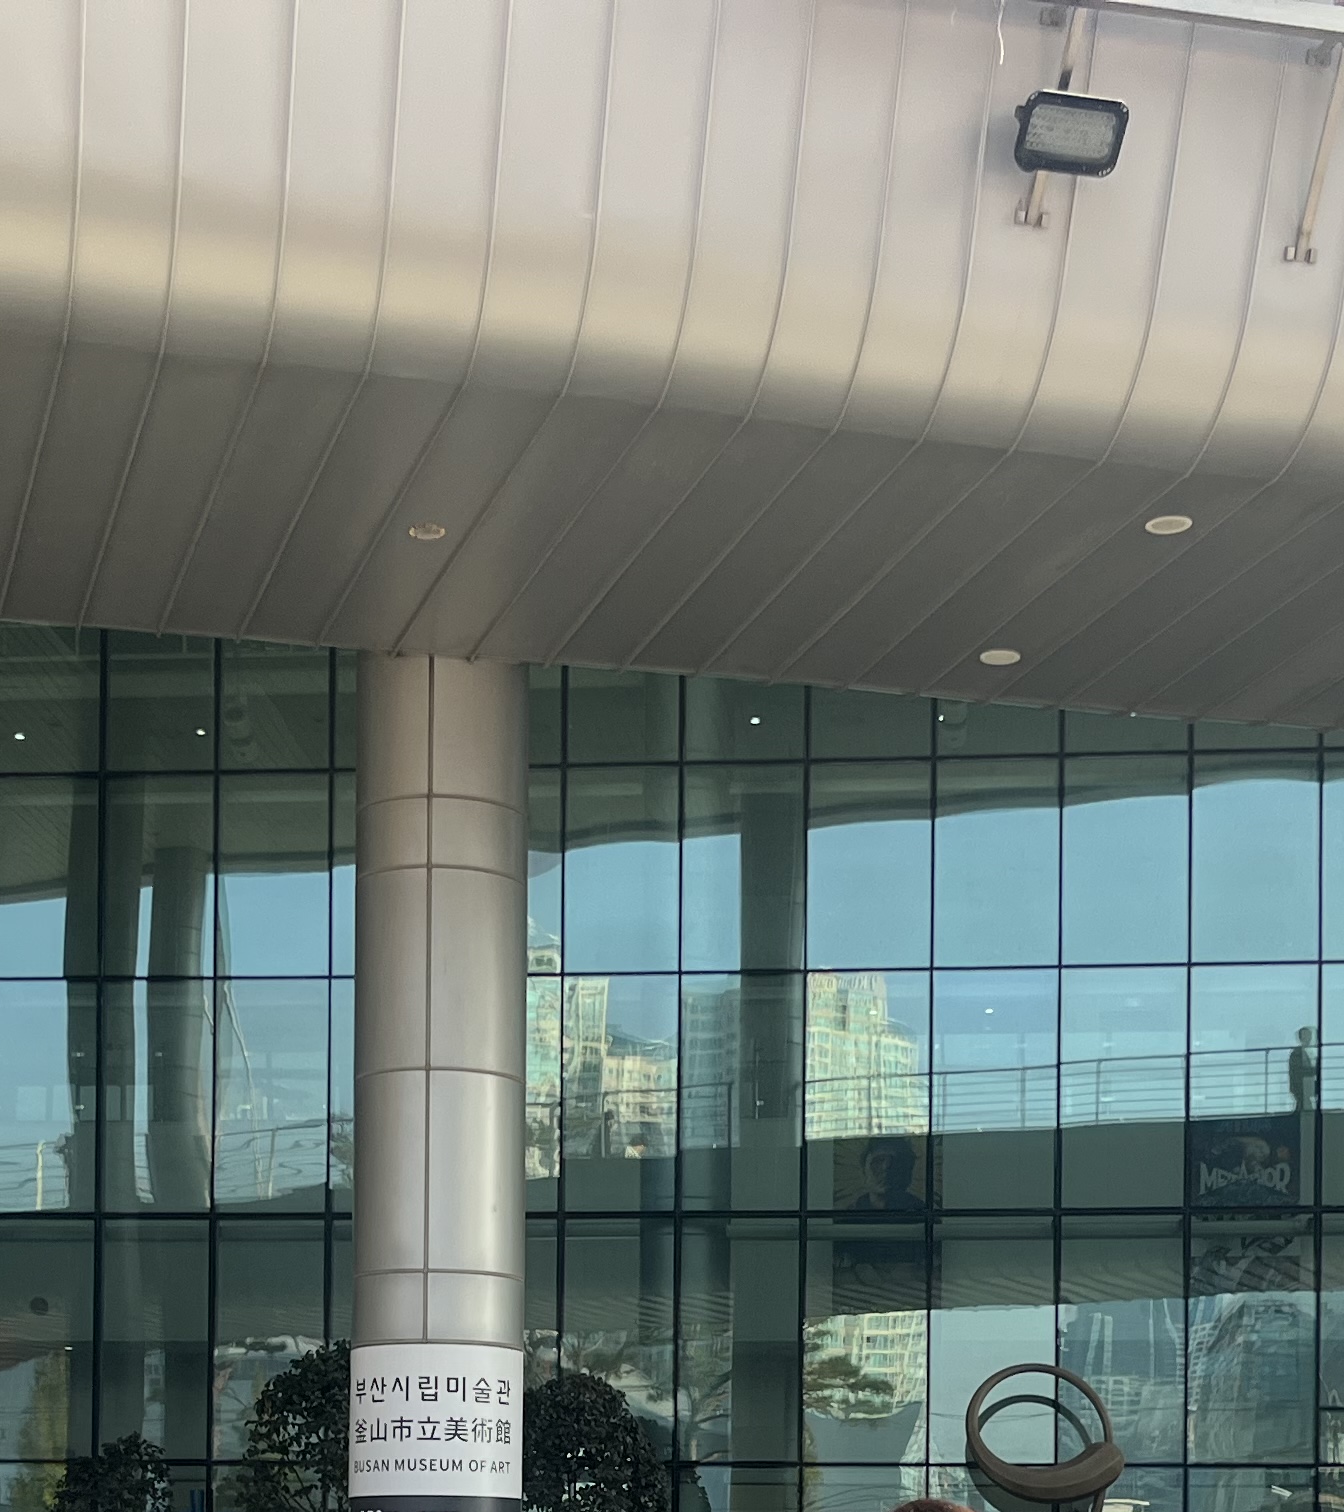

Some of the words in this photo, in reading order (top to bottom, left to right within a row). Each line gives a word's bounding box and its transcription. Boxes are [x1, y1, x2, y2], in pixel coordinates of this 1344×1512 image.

[355, 1375, 511, 1406] 부산시립미술관
[354, 1416, 512, 1445] 釜山市立美術館
[354, 1459, 390, 1475] BUSAN
[394, 1457, 464, 1473] MUSEUM
[468, 1459, 487, 1473] OF
[490, 1460, 511, 1475] ART
